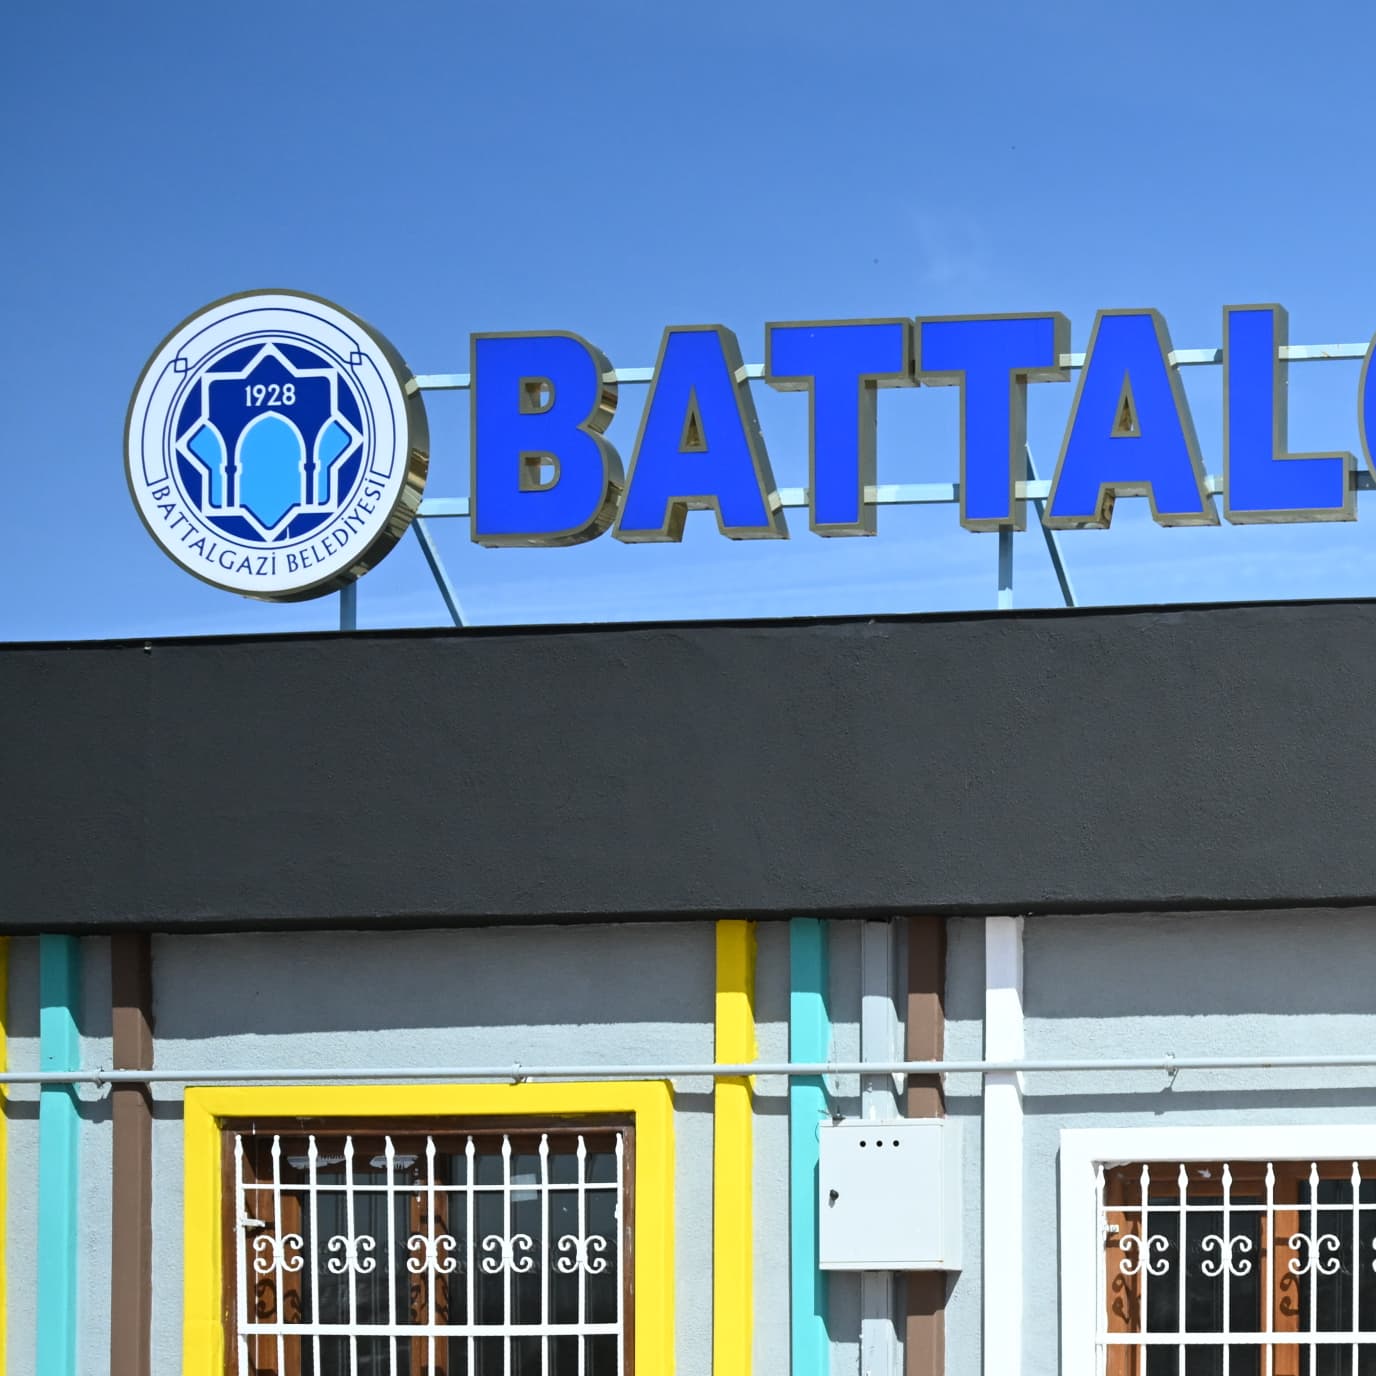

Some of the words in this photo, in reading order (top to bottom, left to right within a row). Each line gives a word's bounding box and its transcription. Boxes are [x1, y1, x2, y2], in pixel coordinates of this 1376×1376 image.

[244, 383, 297, 407] 1928
[152, 485, 277, 575] BATTALGAZİ
[286, 477, 386, 573] BELEDİYESİ
